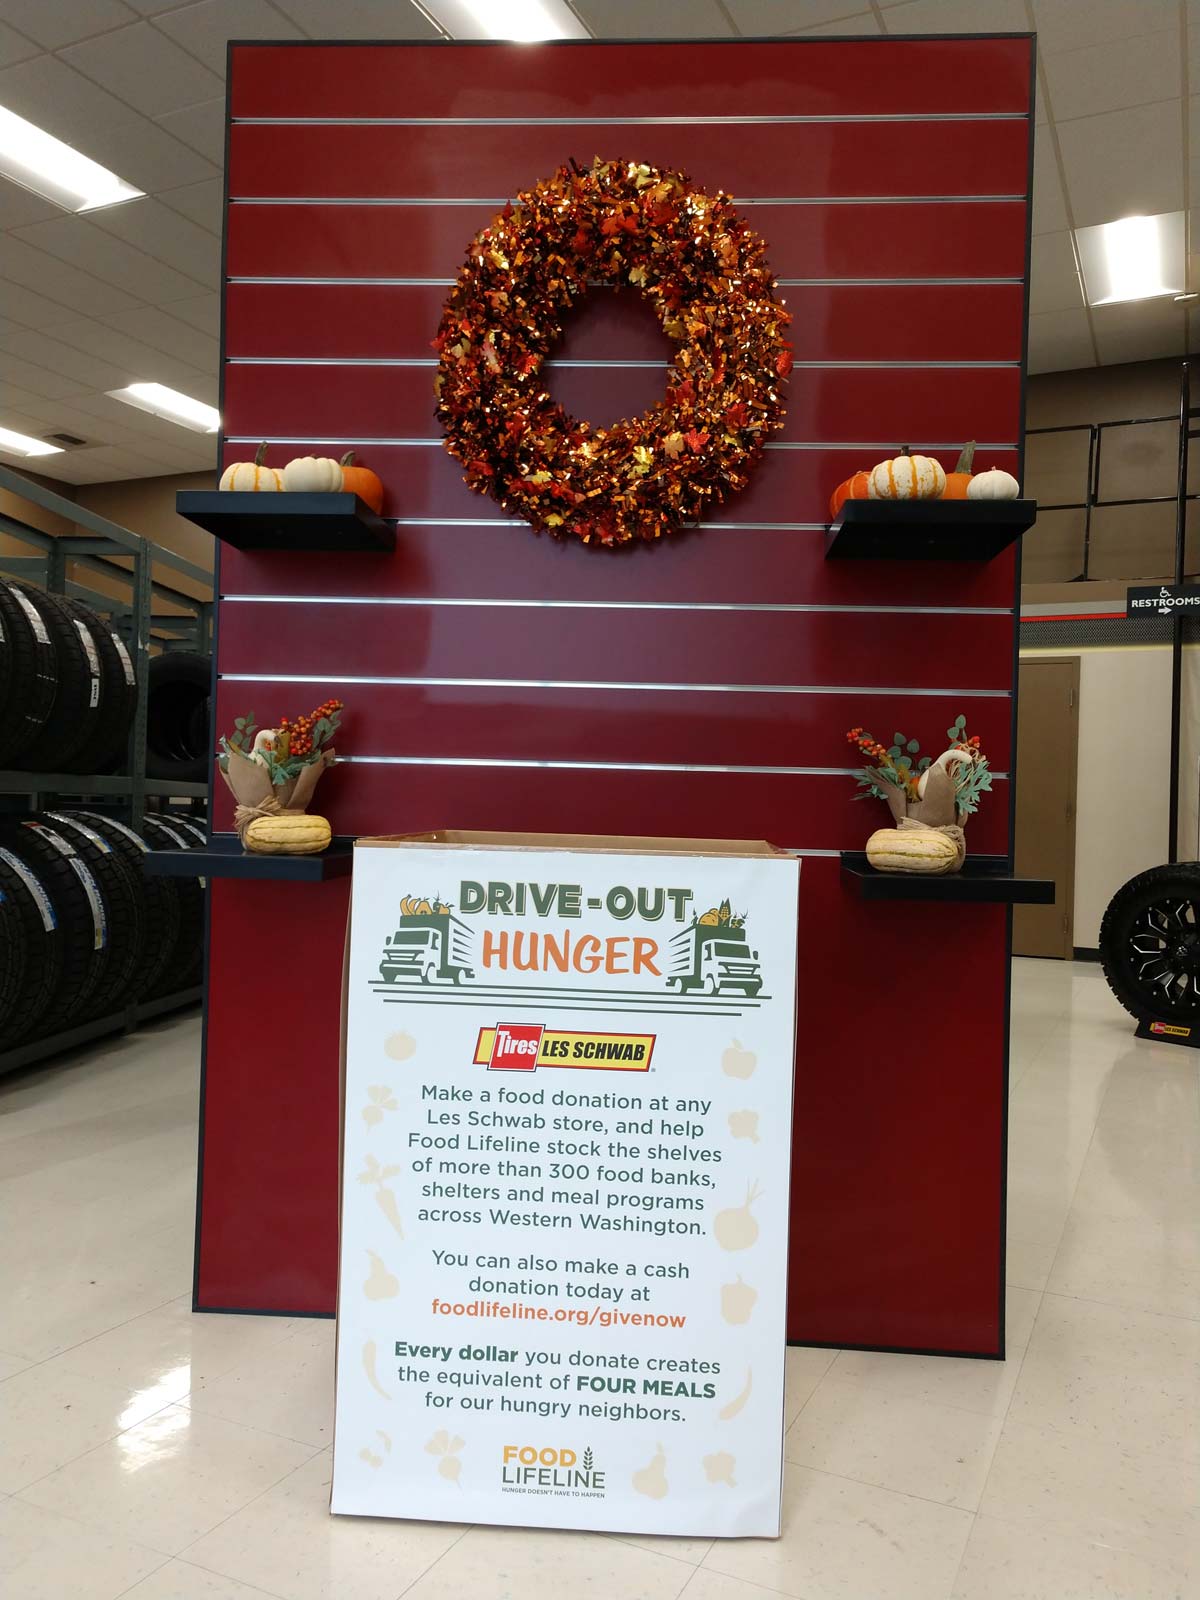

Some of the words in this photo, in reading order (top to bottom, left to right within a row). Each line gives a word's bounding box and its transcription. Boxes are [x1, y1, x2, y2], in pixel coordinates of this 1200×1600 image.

[1132, 597, 1200, 608] RESTROOMS
[460, 881, 693, 922] DRIVE-OUT
[483, 929, 662, 976] HUNGER
[496, 1030, 538, 1057] Tires
[542, 1039, 569, 1058] LES
[572, 1041, 645, 1061] SCHWAB
[422, 1085, 472, 1101] Make
[480, 1091, 490, 1102] a
[498, 1088, 544, 1104] food
[552, 1090, 641, 1109] donation
[650, 1096, 668, 1110] at
[676, 1100, 711, 1115] any
[428, 1110, 460, 1125] Les
[468, 1111, 545, 1129] Schwab
[553, 1116, 608, 1135] store,
[616, 1119, 652, 1134] and
[661, 1120, 704, 1139] help
[409, 1133, 459, 1149] Food
[468, 1135, 540, 1153] Lifeline
[547, 1140, 600, 1156] stock
[608, 1142, 640, 1158] the
[648, 1144, 721, 1162] shelves
[412, 1157, 432, 1172] of
[440, 1162, 490, 1175] more
[498, 1161, 541, 1177] than
[549, 1164, 589, 1180] 300
[597, 1166, 643, 1182] food
[652, 1168, 715, 1189] banks,
[422, 1182, 500, 1200] shelters
[508, 1187, 543, 1202] and
[552, 1190, 598, 1204] meal
[607, 1194, 704, 1210] programs
[418, 1210, 481, 1223] across
[490, 1209, 571, 1228] Western
[580, 1214, 706, 1236] Washington.
[432, 1250, 468, 1266] You
[476, 1256, 510, 1268] can
[518, 1255, 557, 1271] also
[566, 1258, 618, 1274] make
[626, 1264, 636, 1276] a
[644, 1263, 688, 1278] cash
[469, 1276, 558, 1296] donation
[566, 1283, 624, 1302] today
[631, 1287, 650, 1301] at
[432, 1299, 686, 1328] foodlifeline.org/givenow
[395, 1342, 452, 1362] Every
[459, 1345, 518, 1362] dollar
[526, 1352, 560, 1366] you
[569, 1350, 639, 1369] donate
[647, 1358, 720, 1374] creates
[398, 1366, 430, 1382] the
[437, 1370, 542, 1388] equivalent
[550, 1374, 570, 1390] of
[577, 1376, 636, 1394] FOUR
[643, 1380, 715, 1398] MEALS
[425, 1392, 453, 1408] for
[460, 1398, 494, 1410] our
[501, 1396, 571, 1418] hungry
[579, 1402, 685, 1421] neighbors.
[504, 1446, 576, 1467] FOOD
[503, 1467, 605, 1488] LIFELINE
